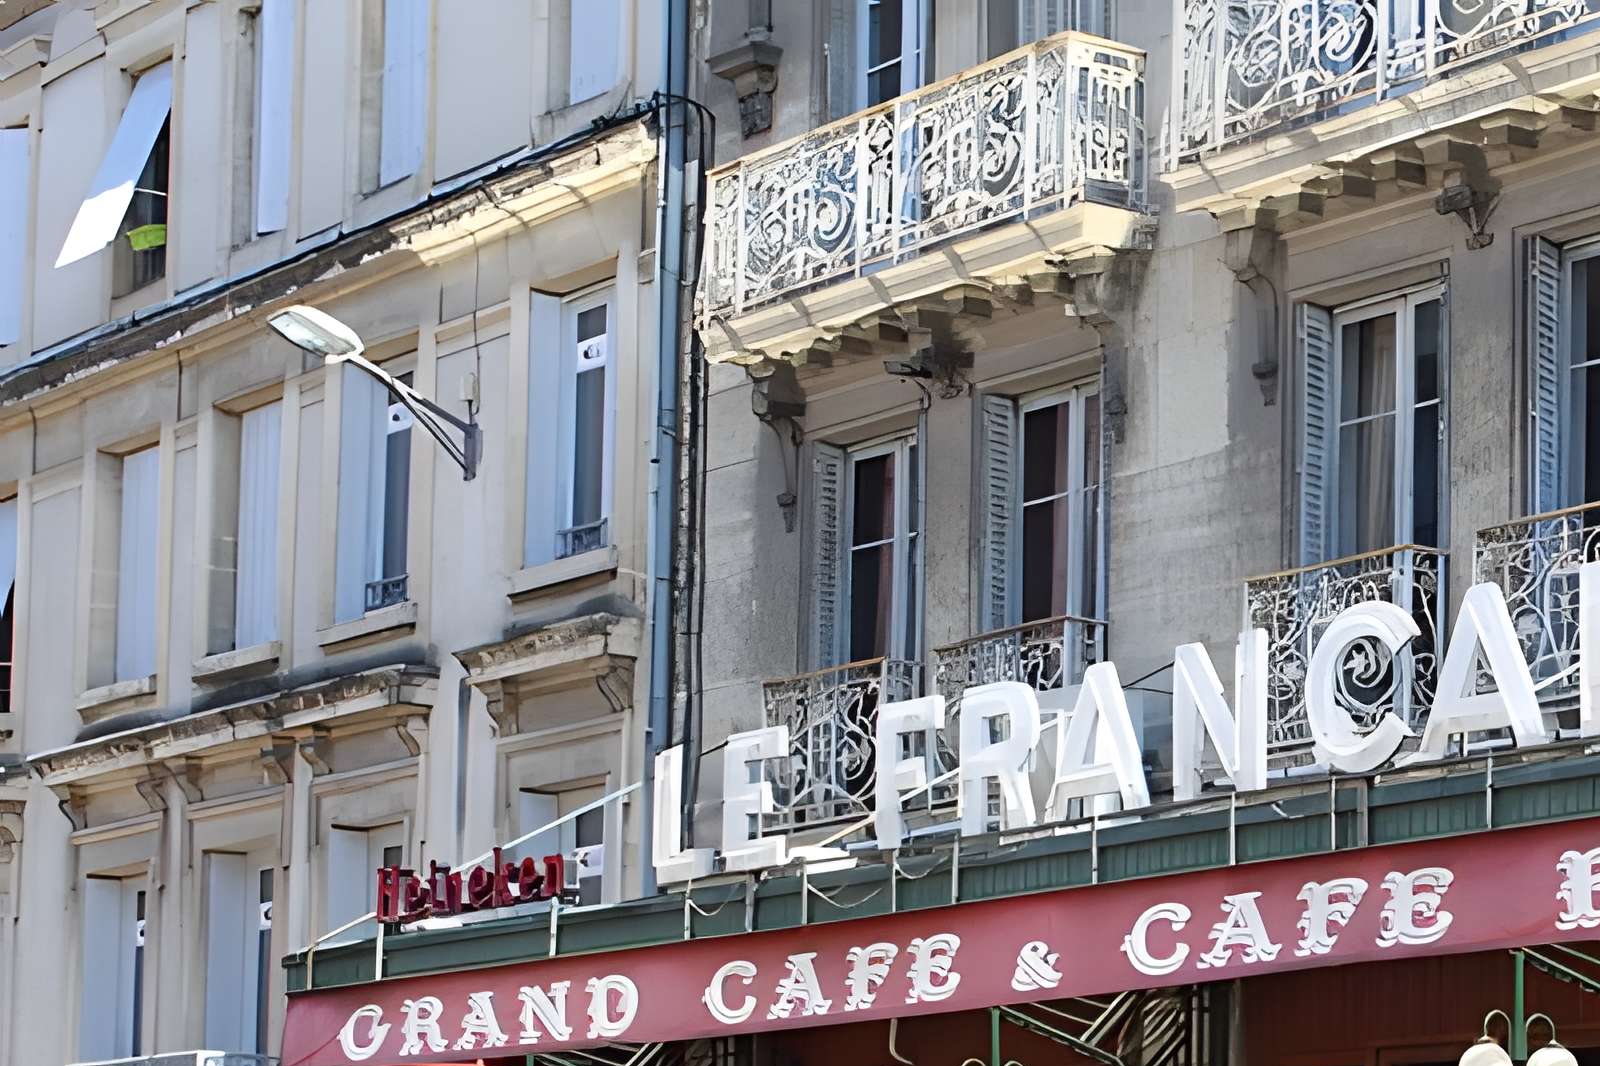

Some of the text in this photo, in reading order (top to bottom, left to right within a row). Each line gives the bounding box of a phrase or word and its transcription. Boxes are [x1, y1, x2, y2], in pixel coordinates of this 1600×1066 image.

[377, 846, 565, 924] Heineken
[652, 724, 790, 888] LE
[338, 974, 640, 1063] GRAND
[702, 932, 962, 1025] CAFE
[1011, 940, 1064, 992] &
[1119, 866, 1454, 976] CAFE
